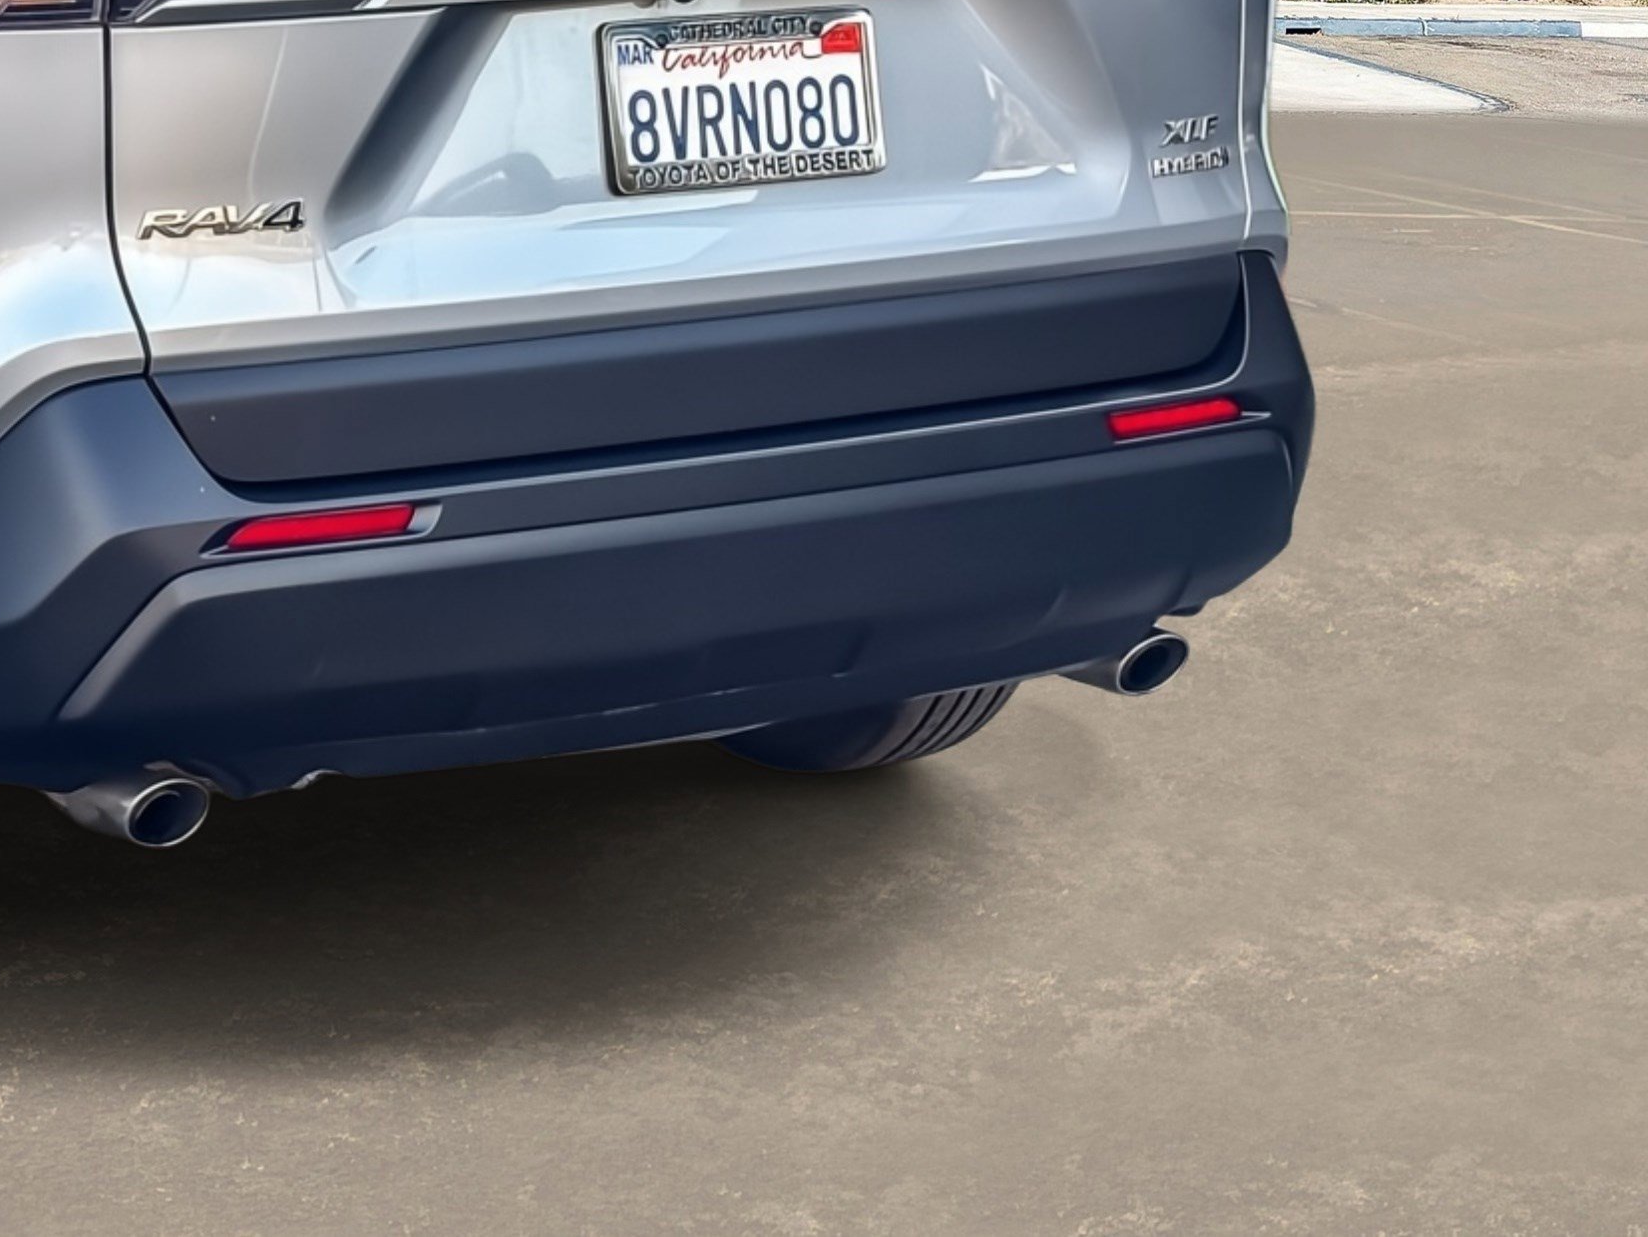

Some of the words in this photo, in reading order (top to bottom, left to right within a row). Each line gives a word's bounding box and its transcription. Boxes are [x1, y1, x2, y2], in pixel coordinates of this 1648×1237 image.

[669, 17, 768, 41] CATHEDRAL
[771, 16, 808, 35] CITY
[616, 43, 654, 66] MAR
[662, 41, 822, 79] California
[628, 74, 860, 164] 8VRN080
[629, 164, 709, 187] TOYOTA
[716, 162, 741, 180] OF
[745, 154, 790, 177] THE
[794, 149, 874, 174] DESERT
[136, 197, 305, 240] RAV4
